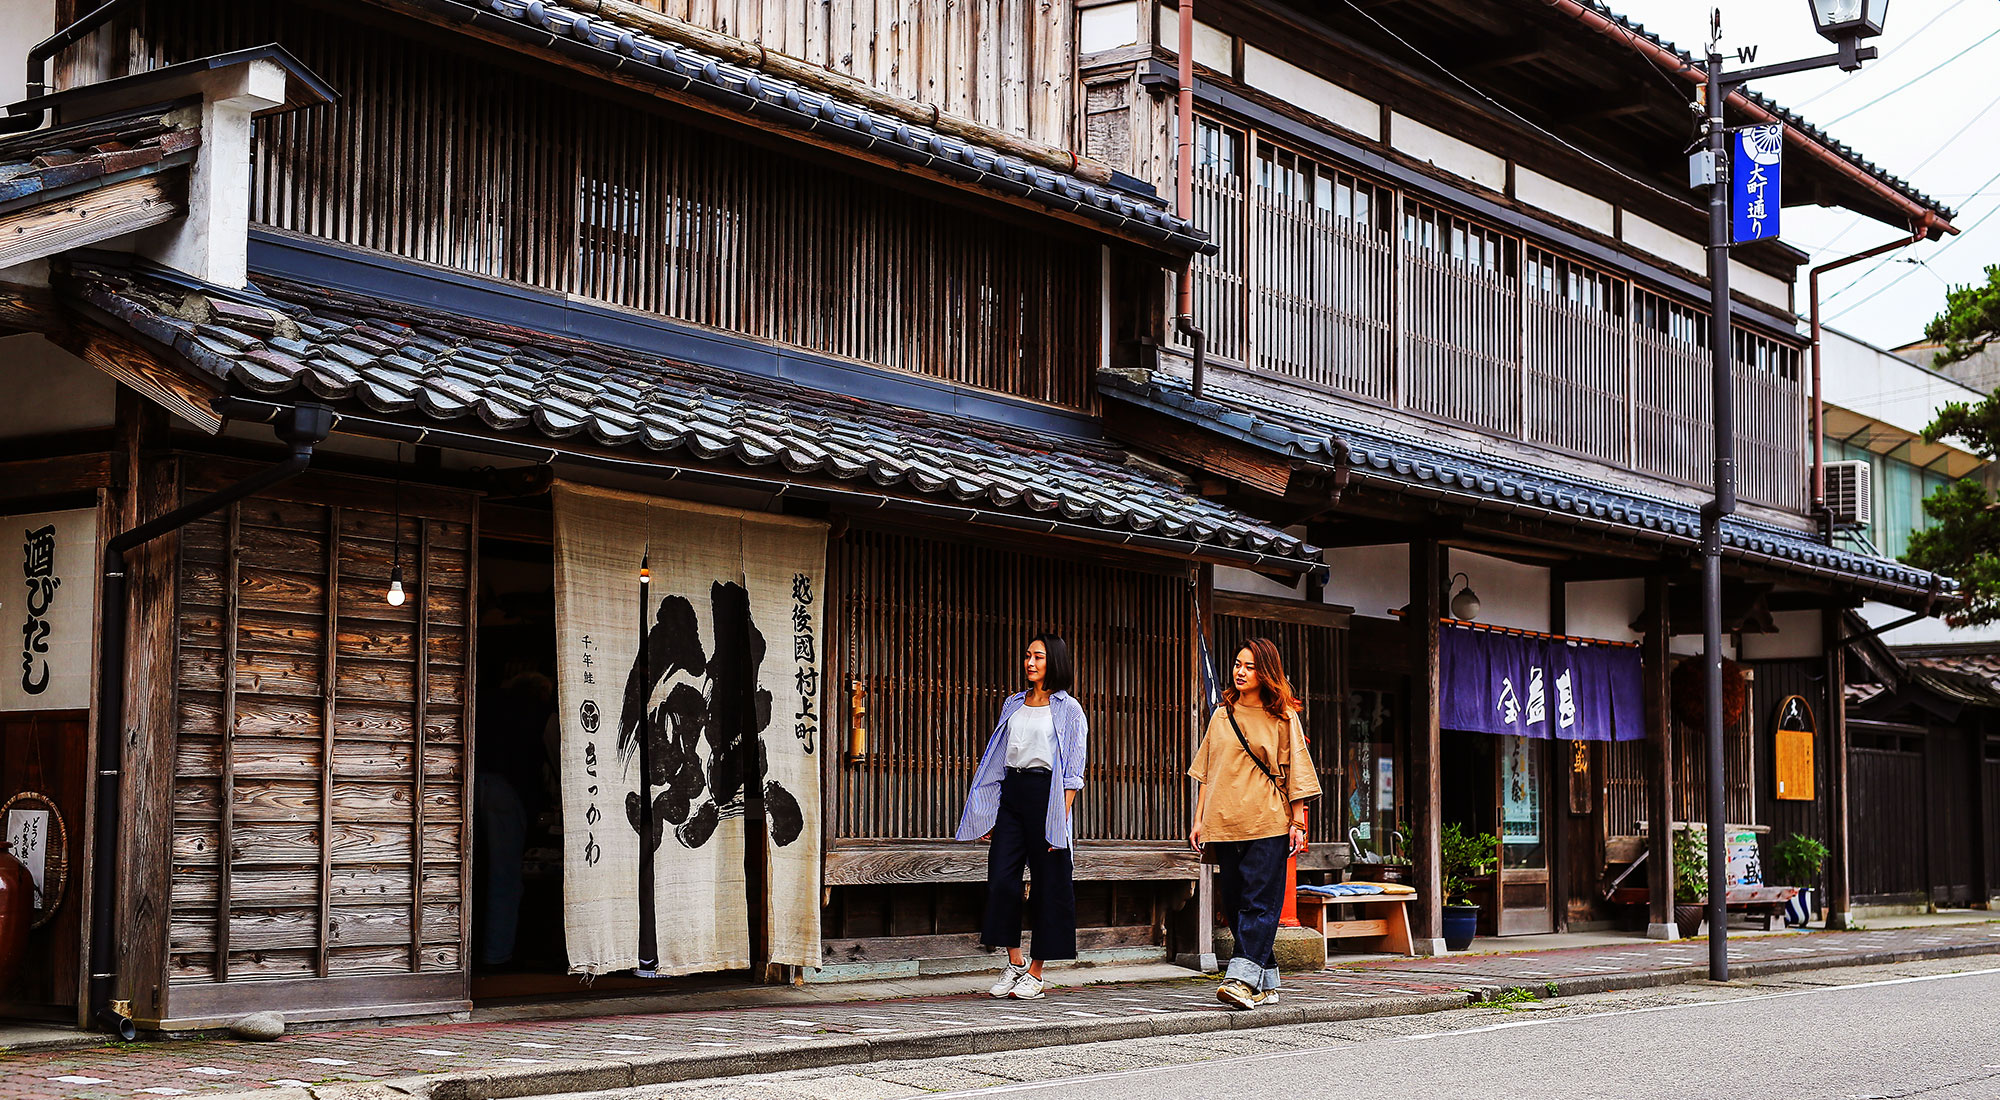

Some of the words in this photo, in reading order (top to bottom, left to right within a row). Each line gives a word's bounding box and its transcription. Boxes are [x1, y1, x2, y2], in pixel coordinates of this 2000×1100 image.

[1737, 45, 1758, 64] W
[1746, 163, 1767, 240] 大町通り
[22, 524, 61, 695] 酒びたし
[581, 635, 596, 684] 千年鮭
[792, 573, 819, 755] 越後國村上町
[31, 816, 40, 851] どうぞ
[585, 741, 602, 867] きっかわ
